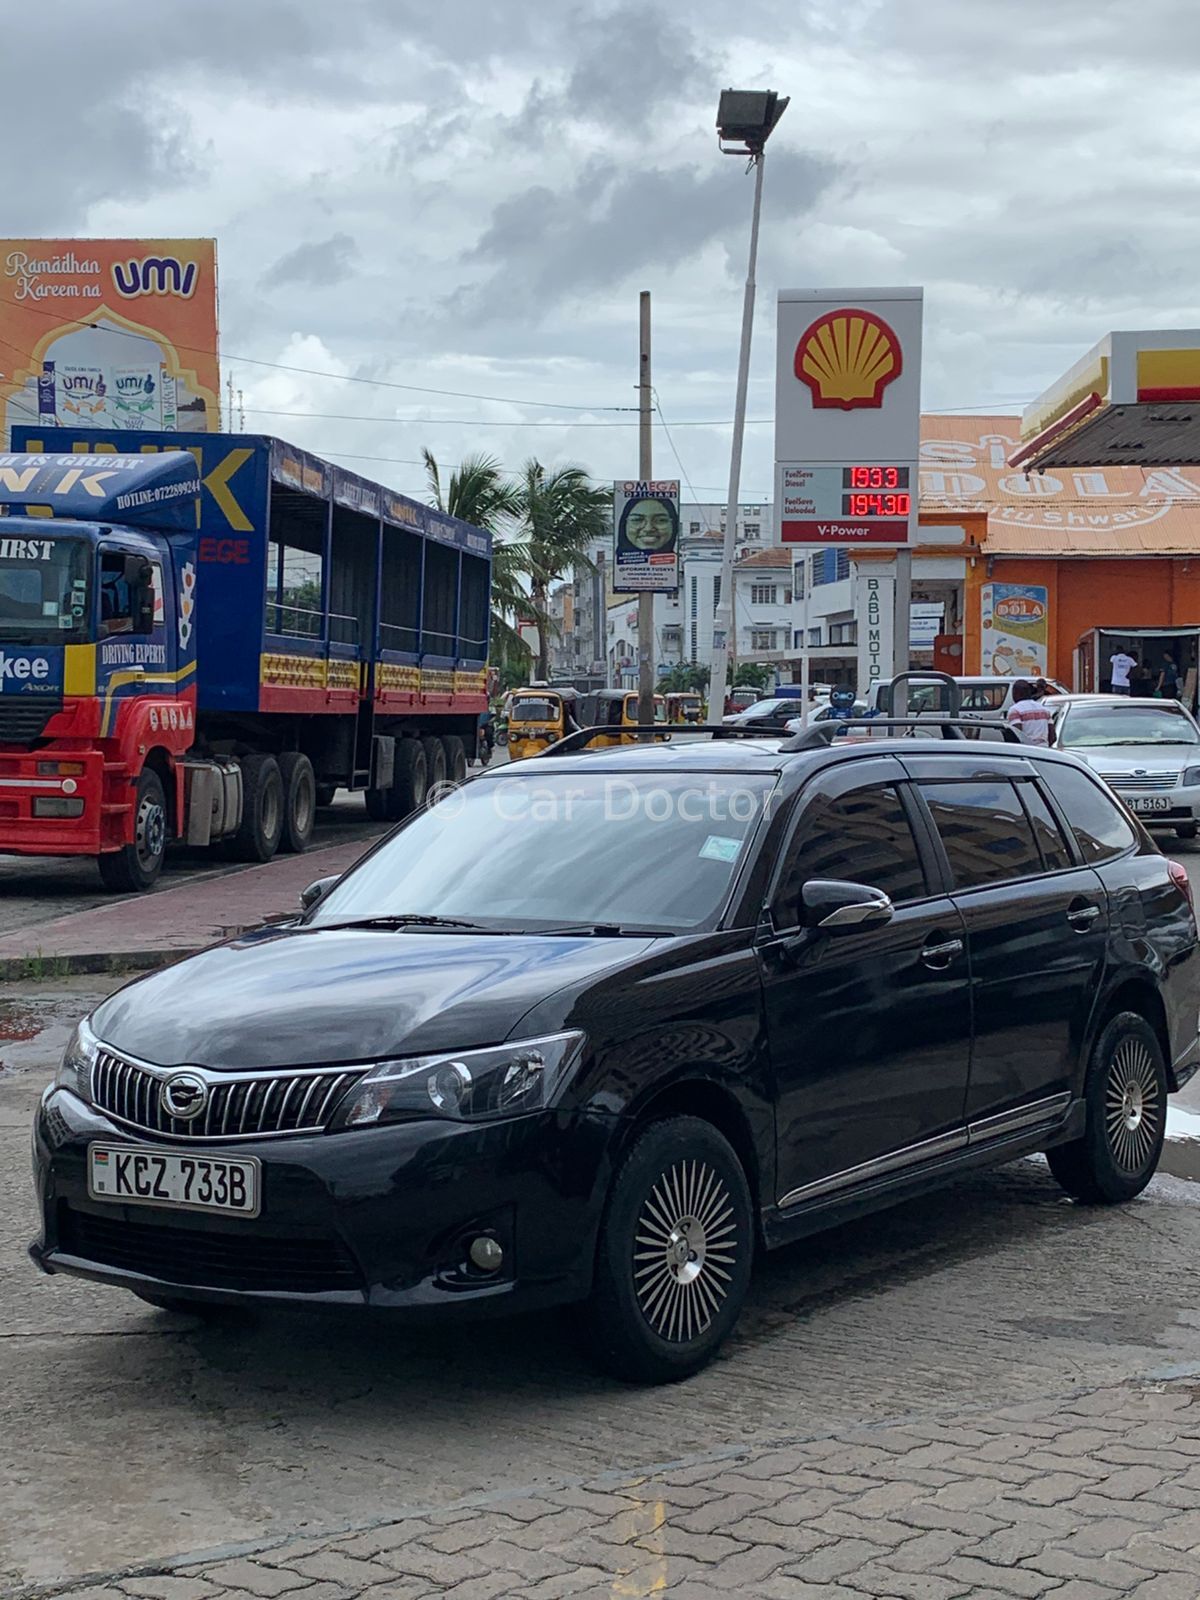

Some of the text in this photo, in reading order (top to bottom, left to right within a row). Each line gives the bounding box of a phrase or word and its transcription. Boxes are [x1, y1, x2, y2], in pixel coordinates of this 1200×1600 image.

[14, 275, 102, 300] Kareem na
[22, 455, 52, 467] IS
[56, 455, 144, 470] GREAT
[623, 481, 678, 493] OMEGA
[784, 479, 806, 488] Diesel
[784, 506, 816, 514] Unleaded
[849, 494, 911, 516] 194.30
[817, 525, 870, 537] V-Power
[867, 578, 880, 626] BABU
[997, 603, 1042, 616] DOLA
[102, 643, 167, 665] DRIVING EXPERTS
[115, 1153, 248, 1207] KCZ 733B
